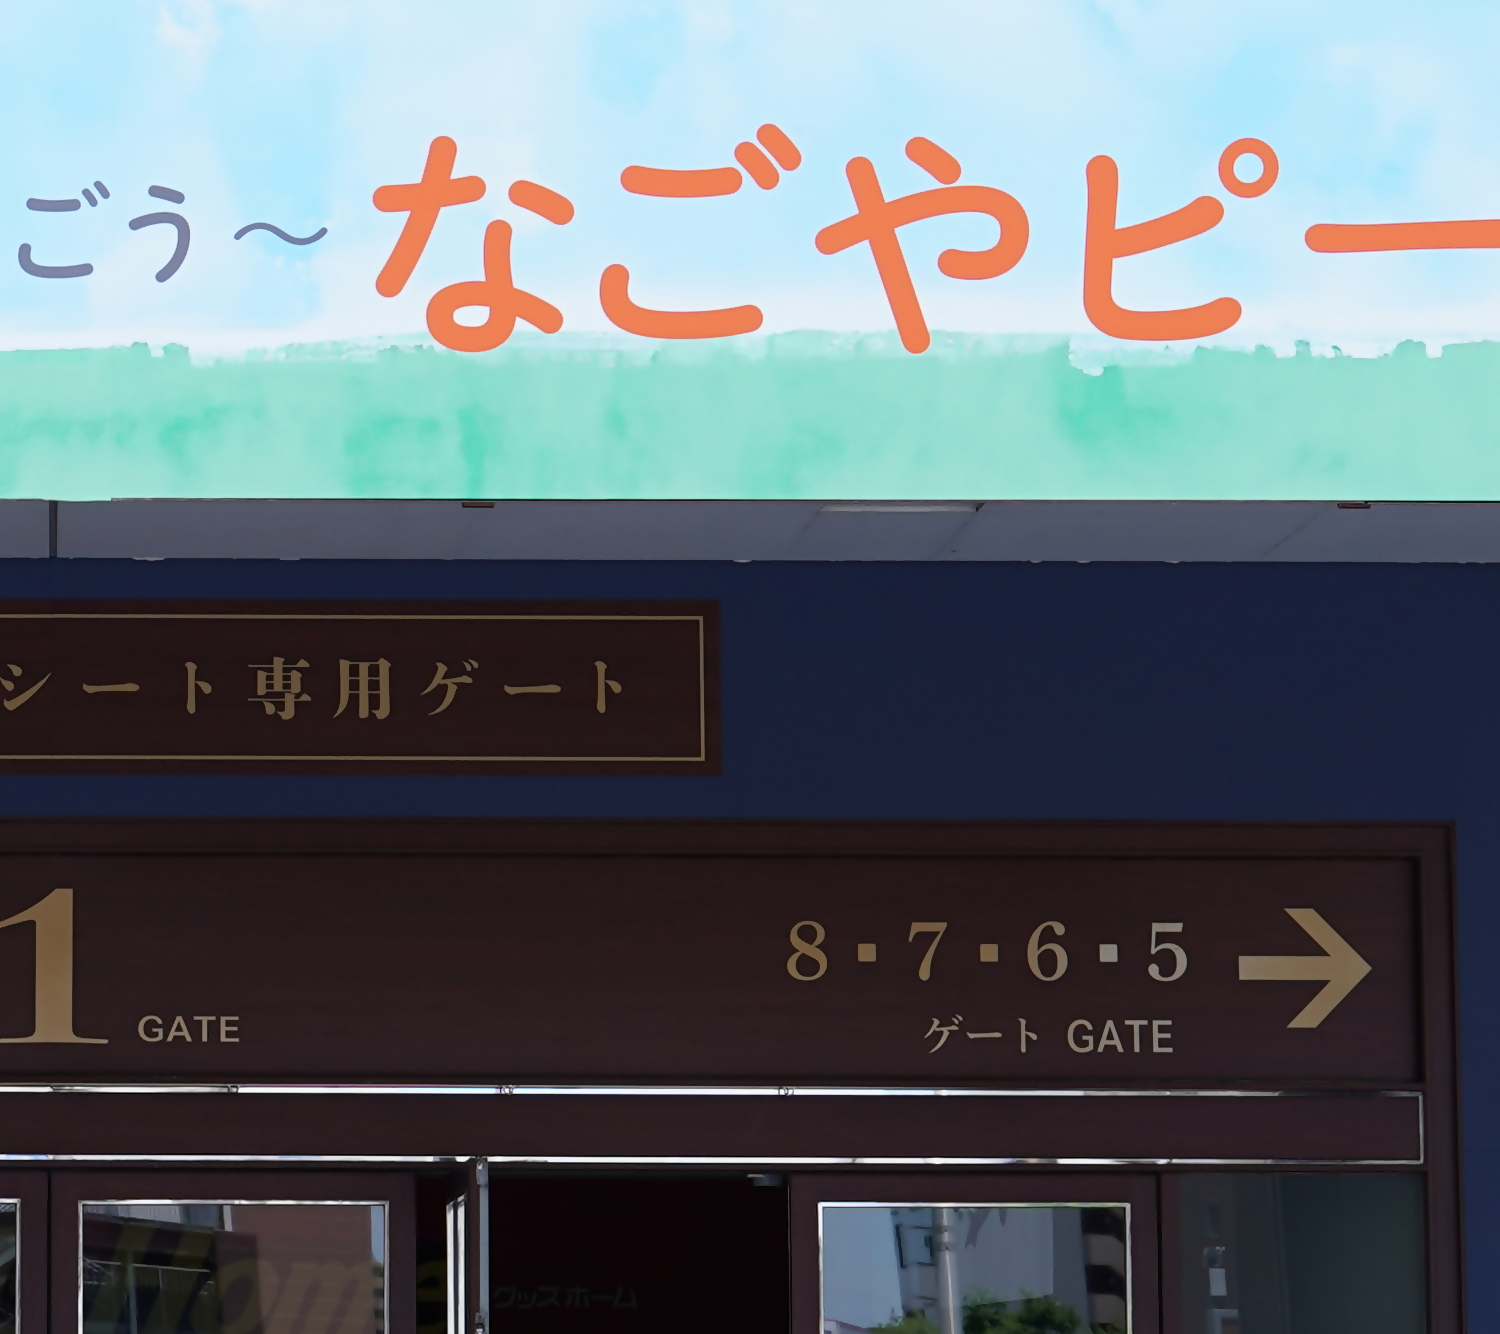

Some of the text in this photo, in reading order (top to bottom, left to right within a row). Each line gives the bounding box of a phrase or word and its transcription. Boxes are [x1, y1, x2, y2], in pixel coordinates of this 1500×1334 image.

[137, 1015, 240, 1043] GATE
[923, 1013, 1174, 1054] ゲート GATE
